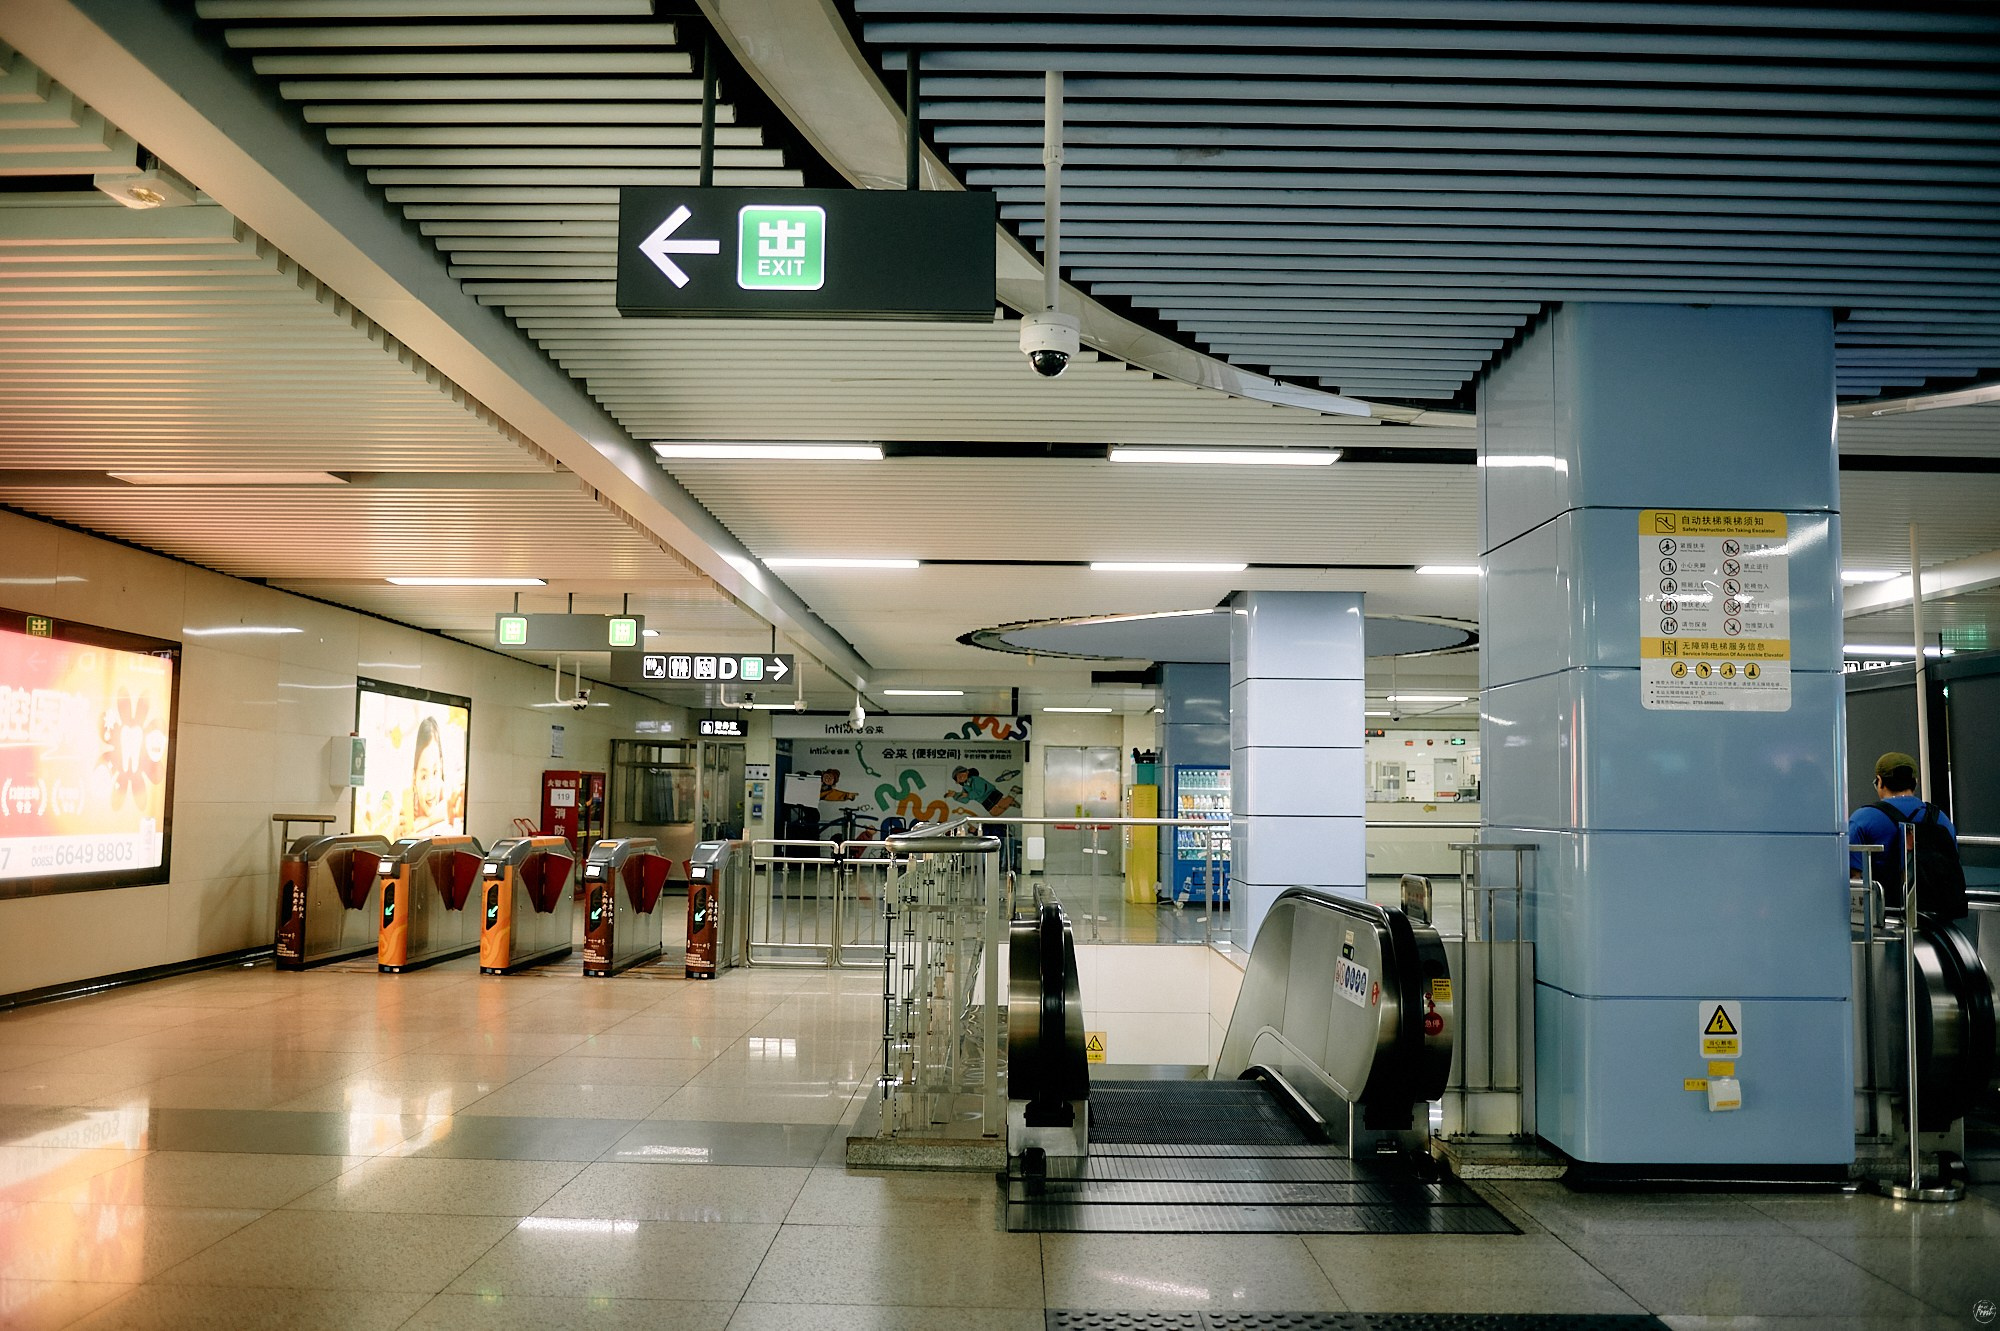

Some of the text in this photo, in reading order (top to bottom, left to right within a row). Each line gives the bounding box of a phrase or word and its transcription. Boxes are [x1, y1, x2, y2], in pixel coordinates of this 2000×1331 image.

[758, 220, 806, 257] 出
[758, 260, 804, 276] EXIT
[1682, 516, 1764, 526] 自动扶梯乘梯须知
[1682, 642, 1765, 651] 无障碍电梯服务信息
[719, 658, 738, 679] D
[547, 779, 576, 787] 火警电话
[56, 843, 94, 865] 6649
[97, 842, 133, 862] 8803
[1425, 1019, 1440, 1027] 急停
